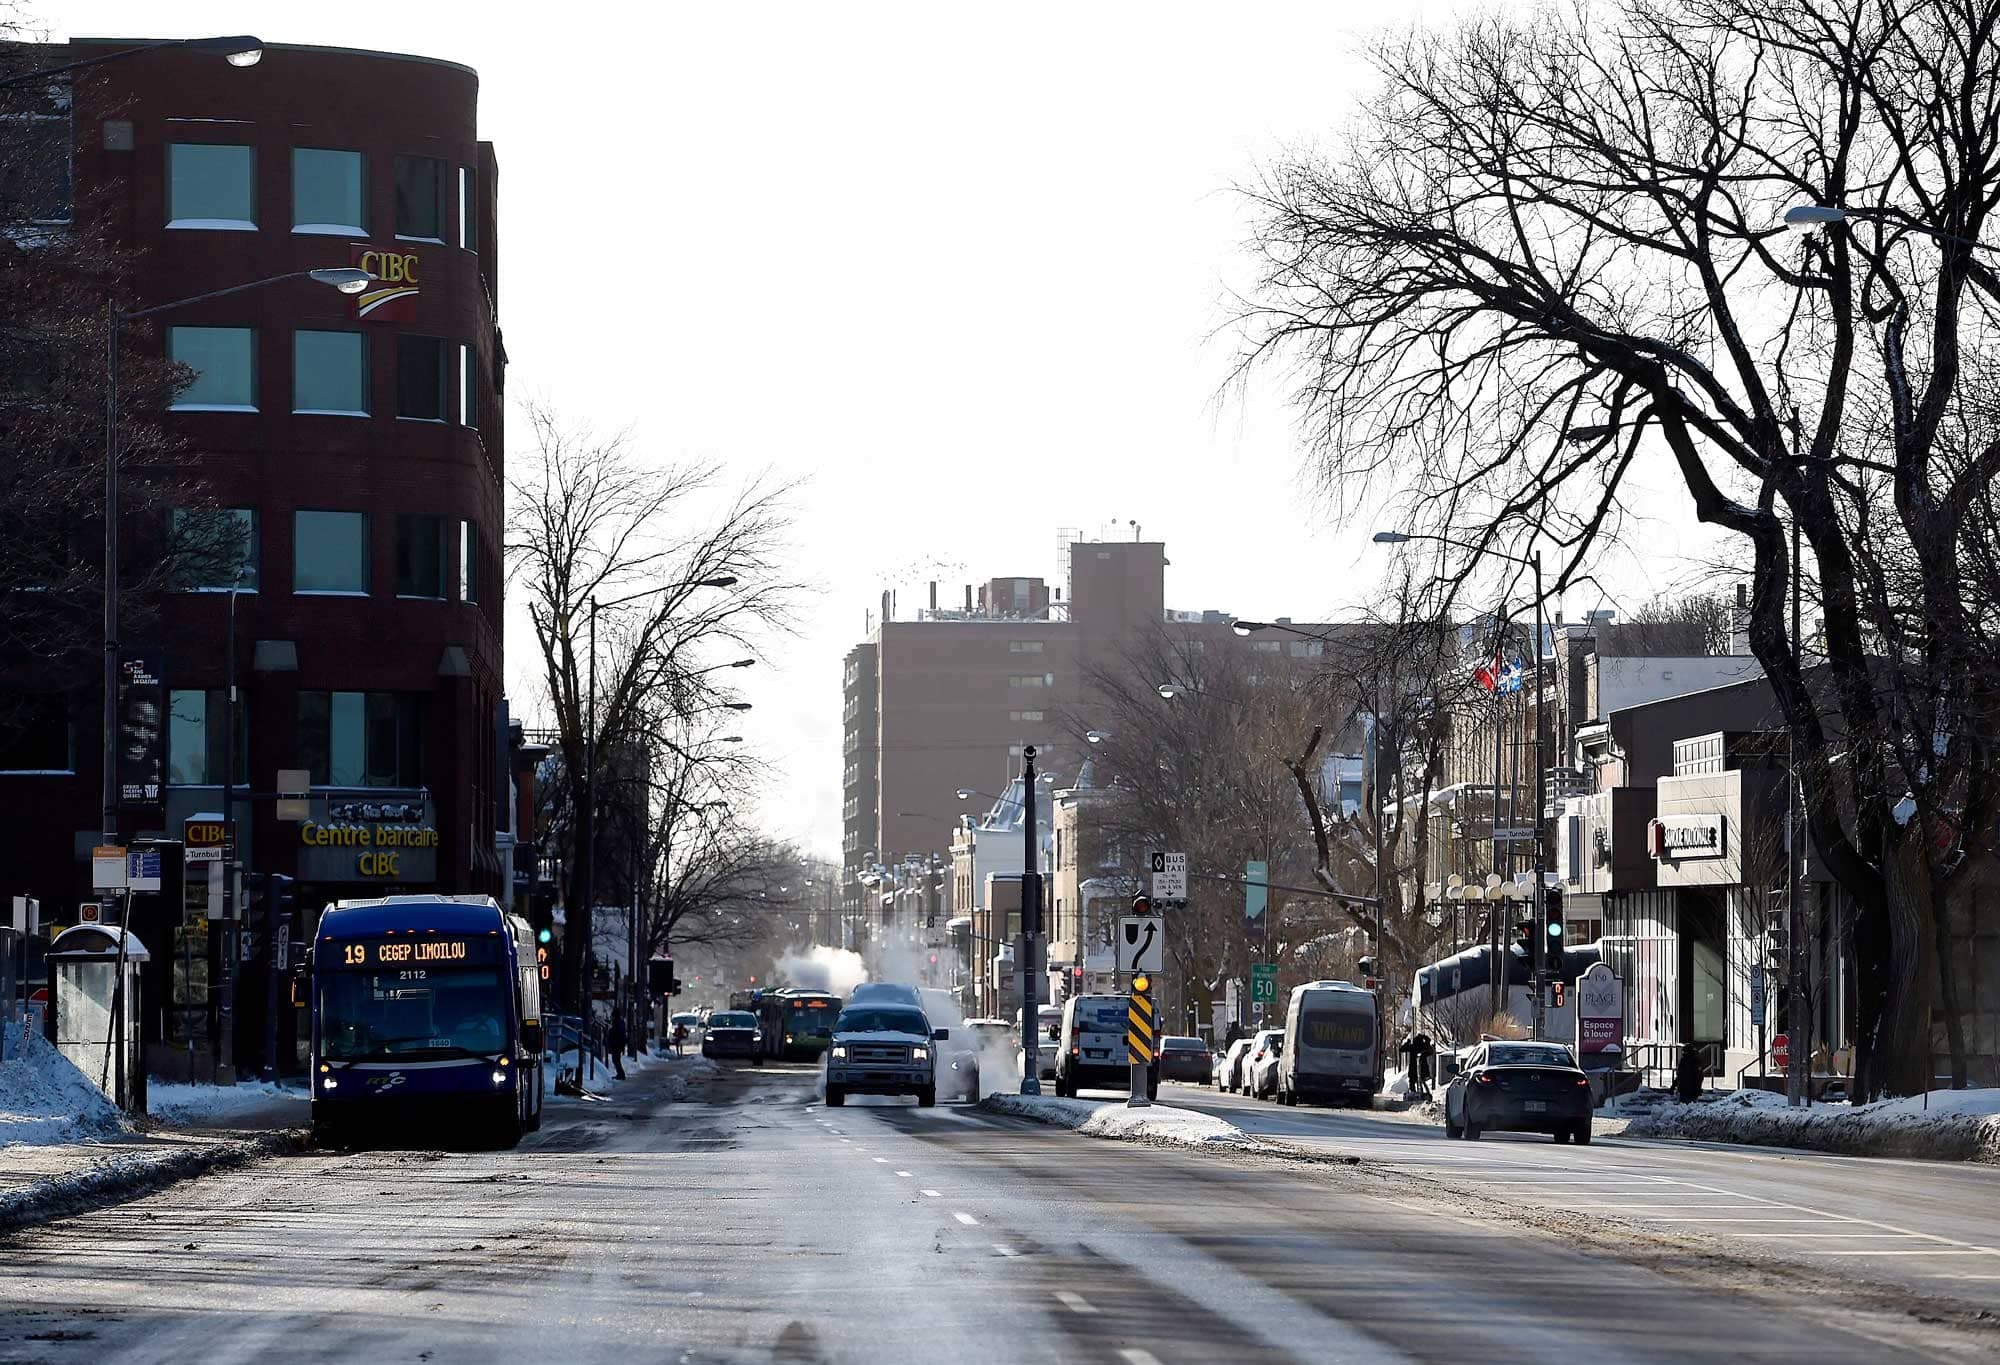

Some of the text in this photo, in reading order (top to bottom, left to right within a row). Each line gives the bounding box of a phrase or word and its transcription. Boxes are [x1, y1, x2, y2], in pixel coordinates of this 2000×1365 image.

[361, 251, 418, 283] CIBC
[301, 822, 439, 847] Centre bancaire
[191, 850, 220, 858] Turnbull
[1165, 855, 1185, 863] BUS
[360, 852, 399, 875] CIBC
[344, 942, 466, 964] 19 CEGEP LIMOILOU
[399, 970, 427, 980] 2112
[1256, 980, 1273, 996] 50
[1585, 993, 1617, 1003] PLACE
[1583, 1020, 1615, 1030] Espace
[1583, 1029, 1614, 1038] à louer
